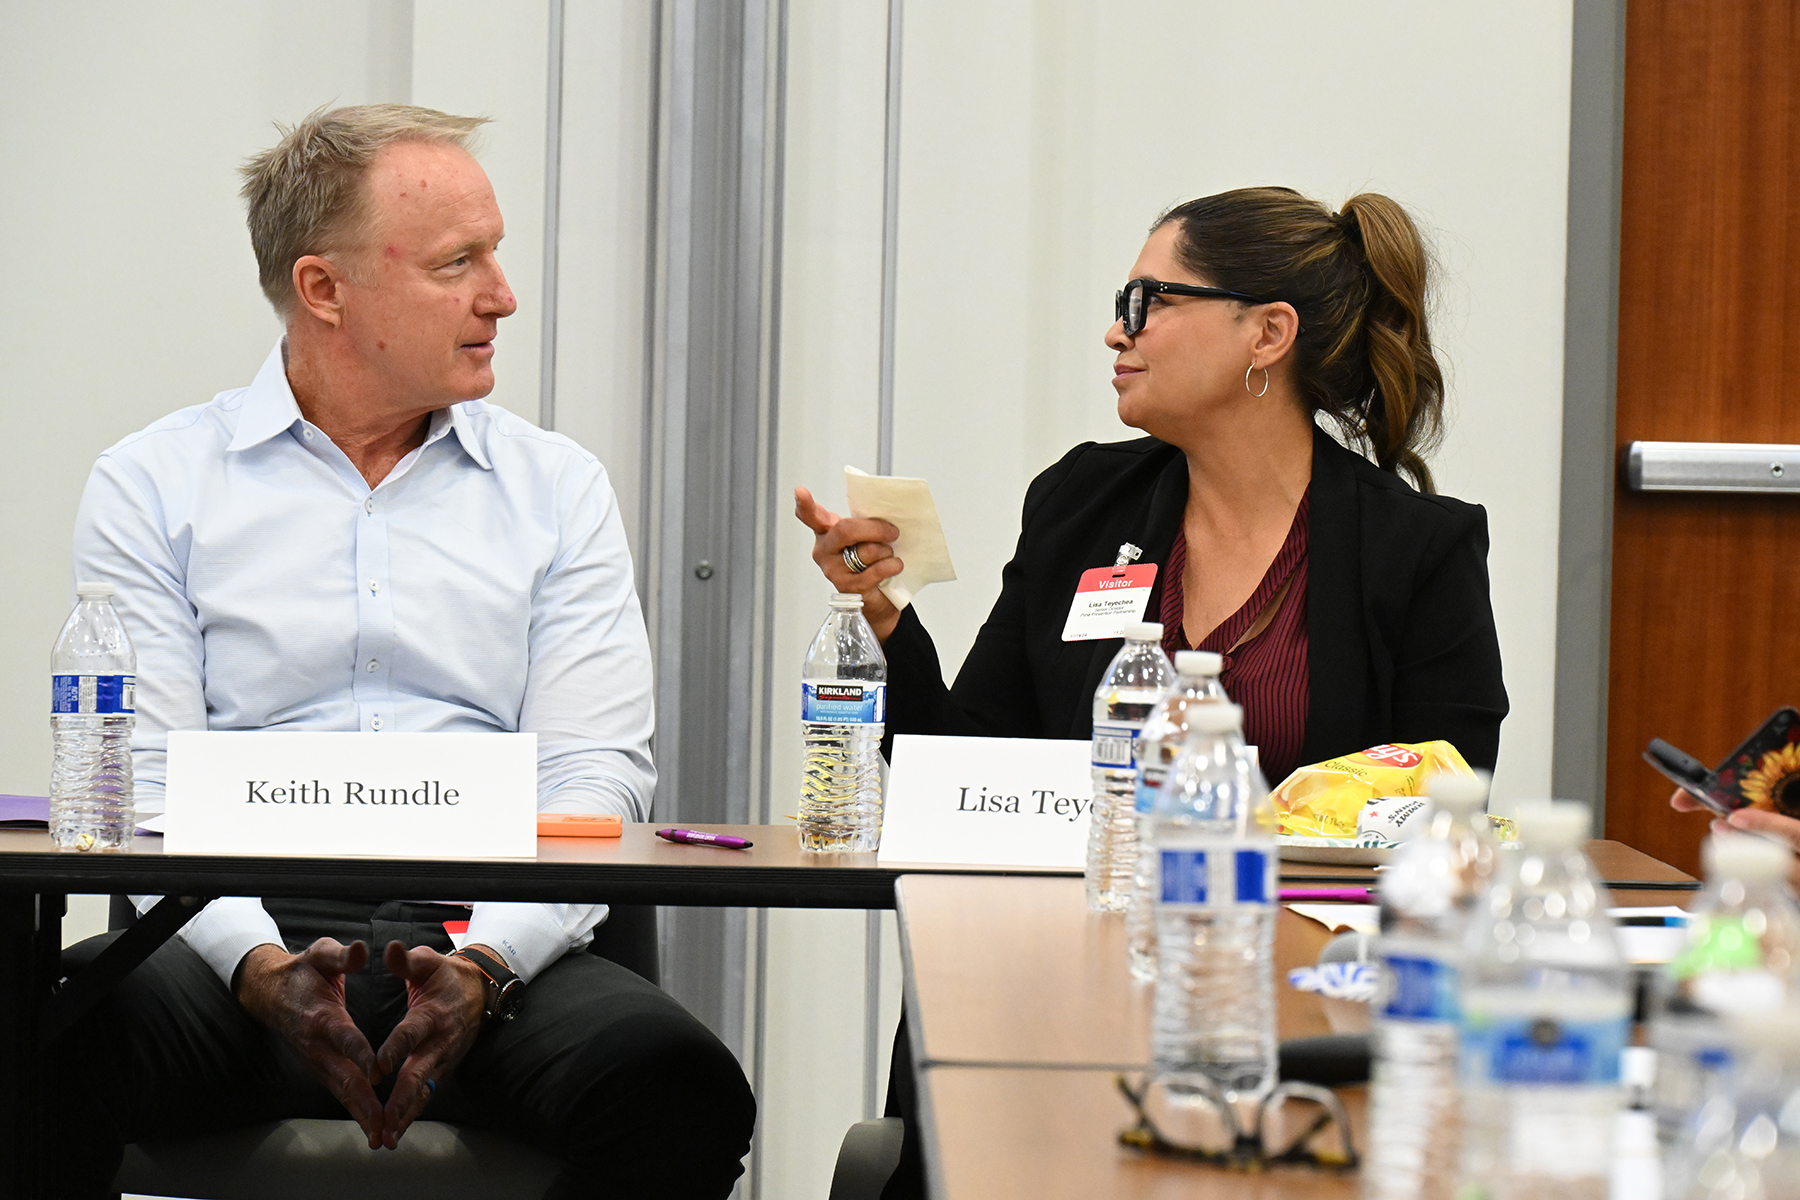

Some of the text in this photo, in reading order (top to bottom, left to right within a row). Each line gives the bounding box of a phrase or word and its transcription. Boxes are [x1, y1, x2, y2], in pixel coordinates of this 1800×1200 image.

[1099, 579, 1133, 589] Visitor
[818, 686, 862, 696] KIRKLAND
[816, 703, 863, 711] purified water
[1324, 760, 1368, 777] Classic
[245, 779, 460, 806] Keith Rundle
[956, 786, 1021, 814] Lisa
